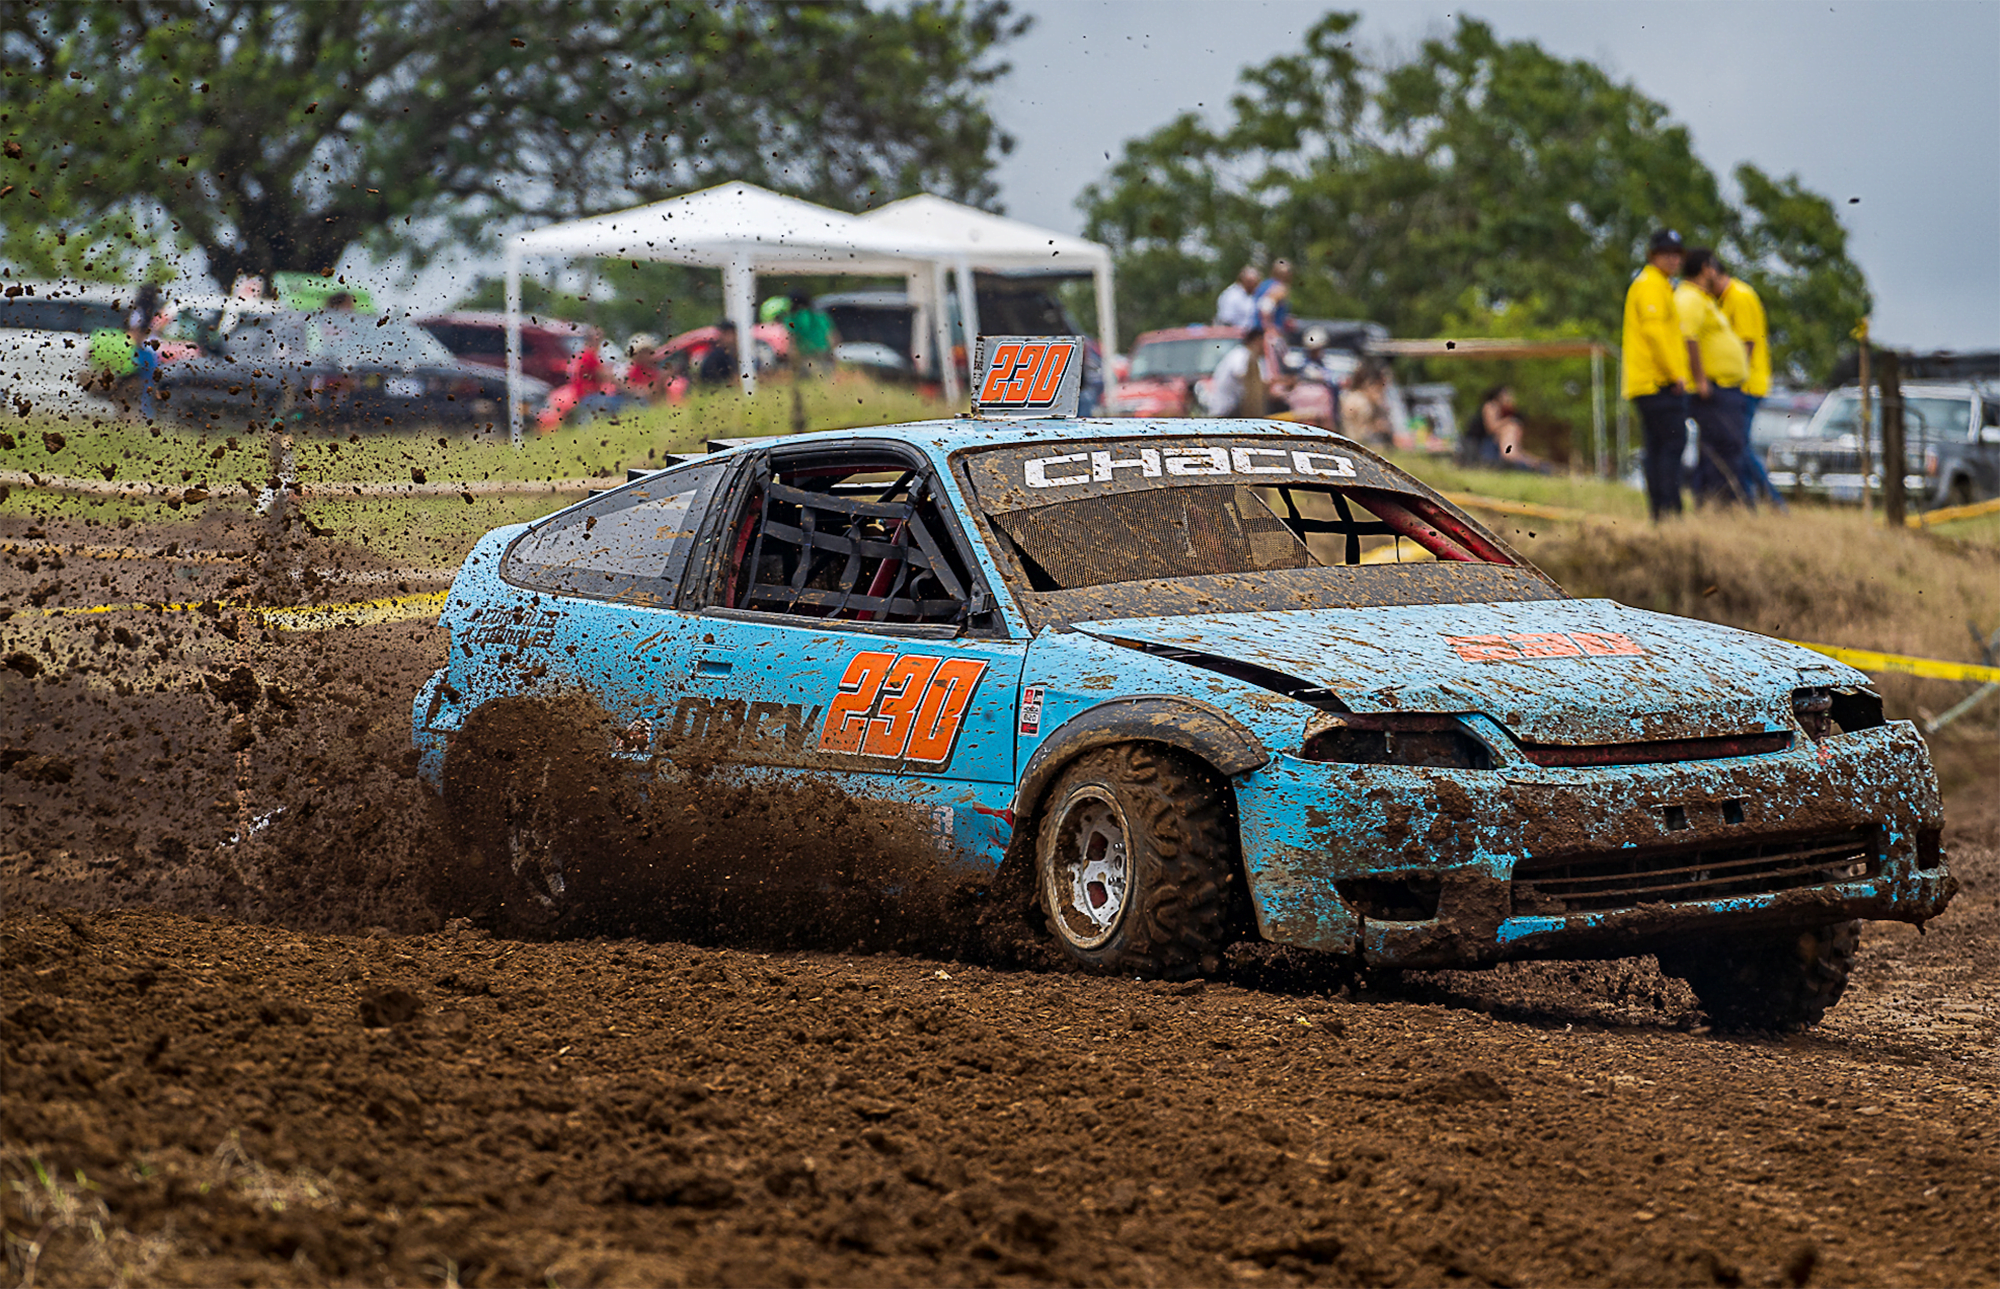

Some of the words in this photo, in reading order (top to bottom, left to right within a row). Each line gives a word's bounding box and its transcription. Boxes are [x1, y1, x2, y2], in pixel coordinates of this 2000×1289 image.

[979, 341, 1076, 411] 230
[1443, 633, 1647, 662] 230
[817, 651, 990, 768] 230
